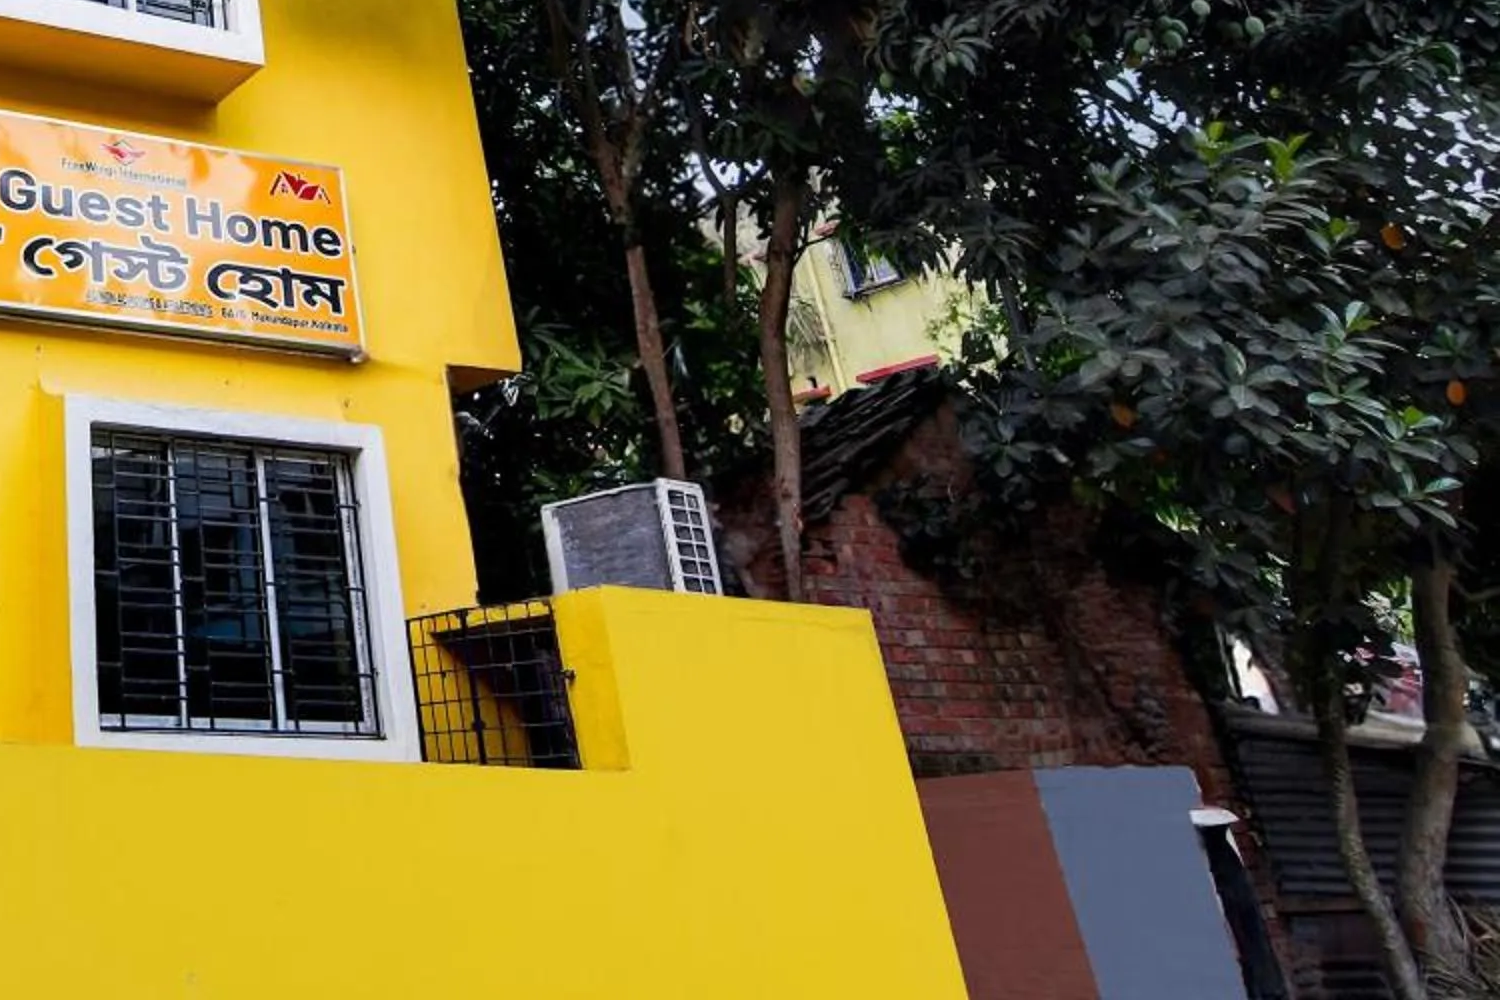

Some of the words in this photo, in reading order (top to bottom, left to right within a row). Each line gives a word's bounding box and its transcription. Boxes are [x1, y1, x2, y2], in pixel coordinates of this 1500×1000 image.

[0, 168, 169, 231] Guest
[188, 198, 342, 257] Home
[23, 235, 188, 291] গেস্ট
[207, 264, 345, 315] হোম
